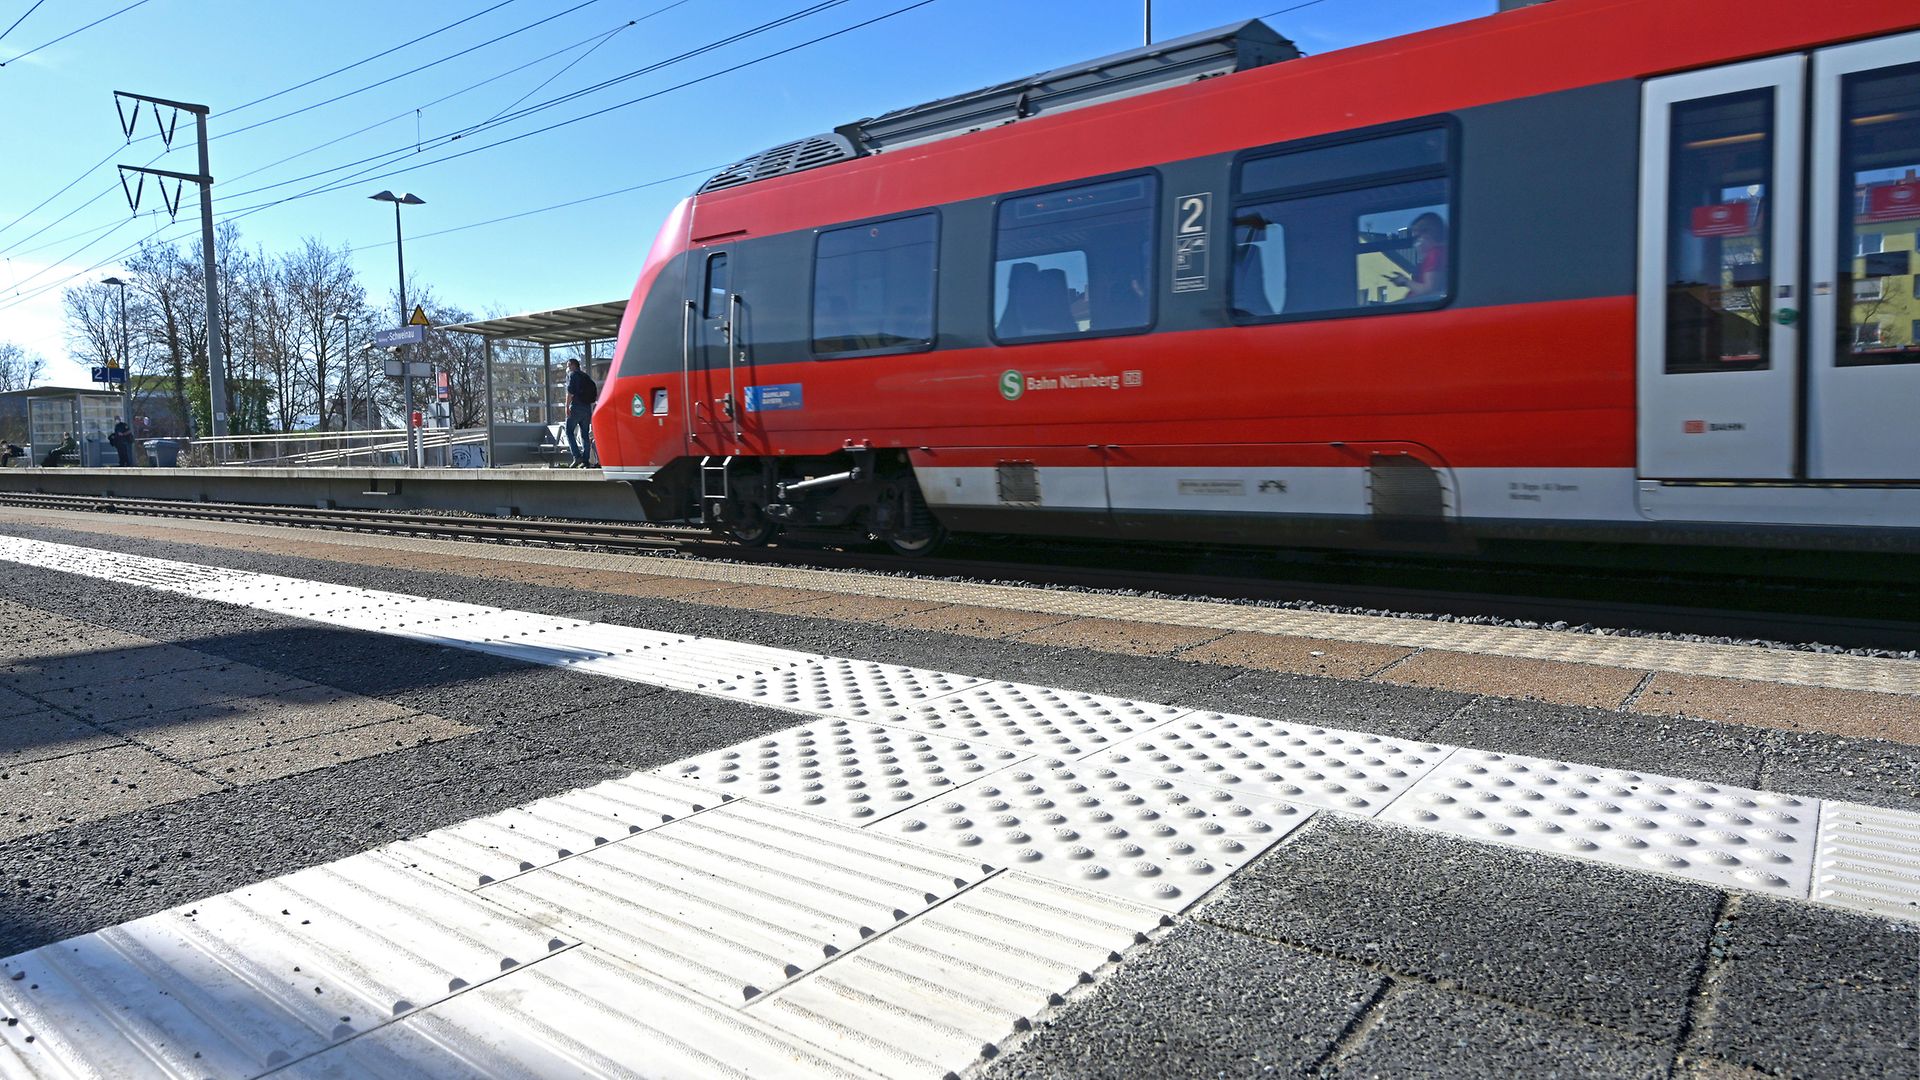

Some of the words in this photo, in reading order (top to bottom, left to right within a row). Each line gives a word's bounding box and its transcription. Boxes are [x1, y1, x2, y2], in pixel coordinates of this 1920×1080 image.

[1181, 198, 1204, 233] 2
[739, 351, 746, 362] 2
[94, 367, 103, 380] 2
[1003, 372, 1020, 398] S
[1026, 376, 1058, 390] Bahn
[1060, 373, 1119, 390] Nürnberg
